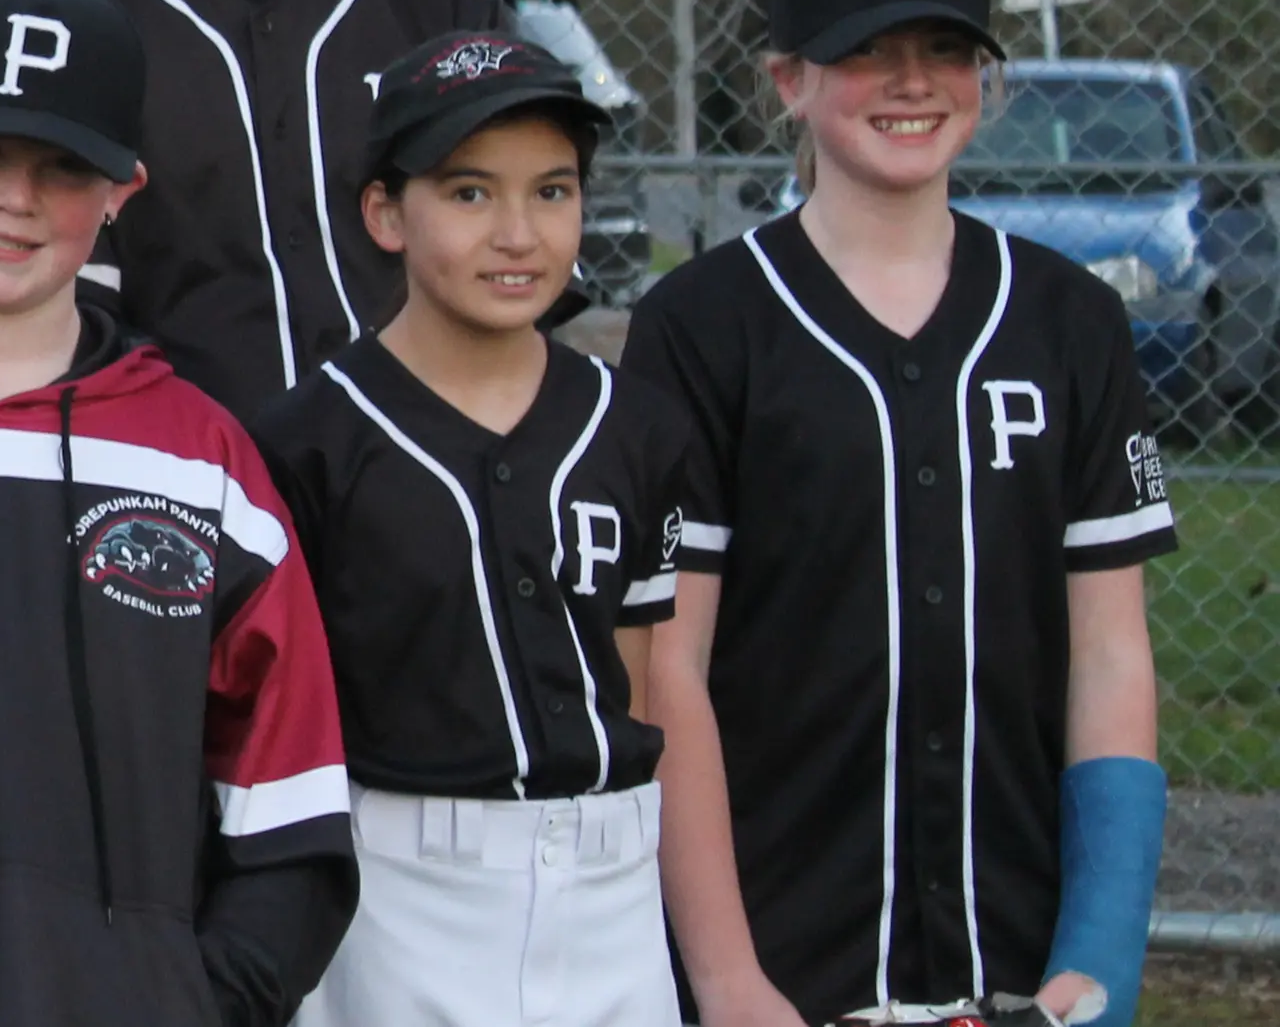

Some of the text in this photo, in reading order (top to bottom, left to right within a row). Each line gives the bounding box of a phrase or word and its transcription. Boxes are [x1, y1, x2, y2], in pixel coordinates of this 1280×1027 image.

[981, 379, 1046, 470] P
[1144, 456, 1163, 479] BEE
[1146, 478, 1167, 501] ICE
[68, 496, 220, 546] OREPUNKAH PANTH
[569, 500, 621, 595] P
[102, 584, 203, 617] BASEBALL CLUB
